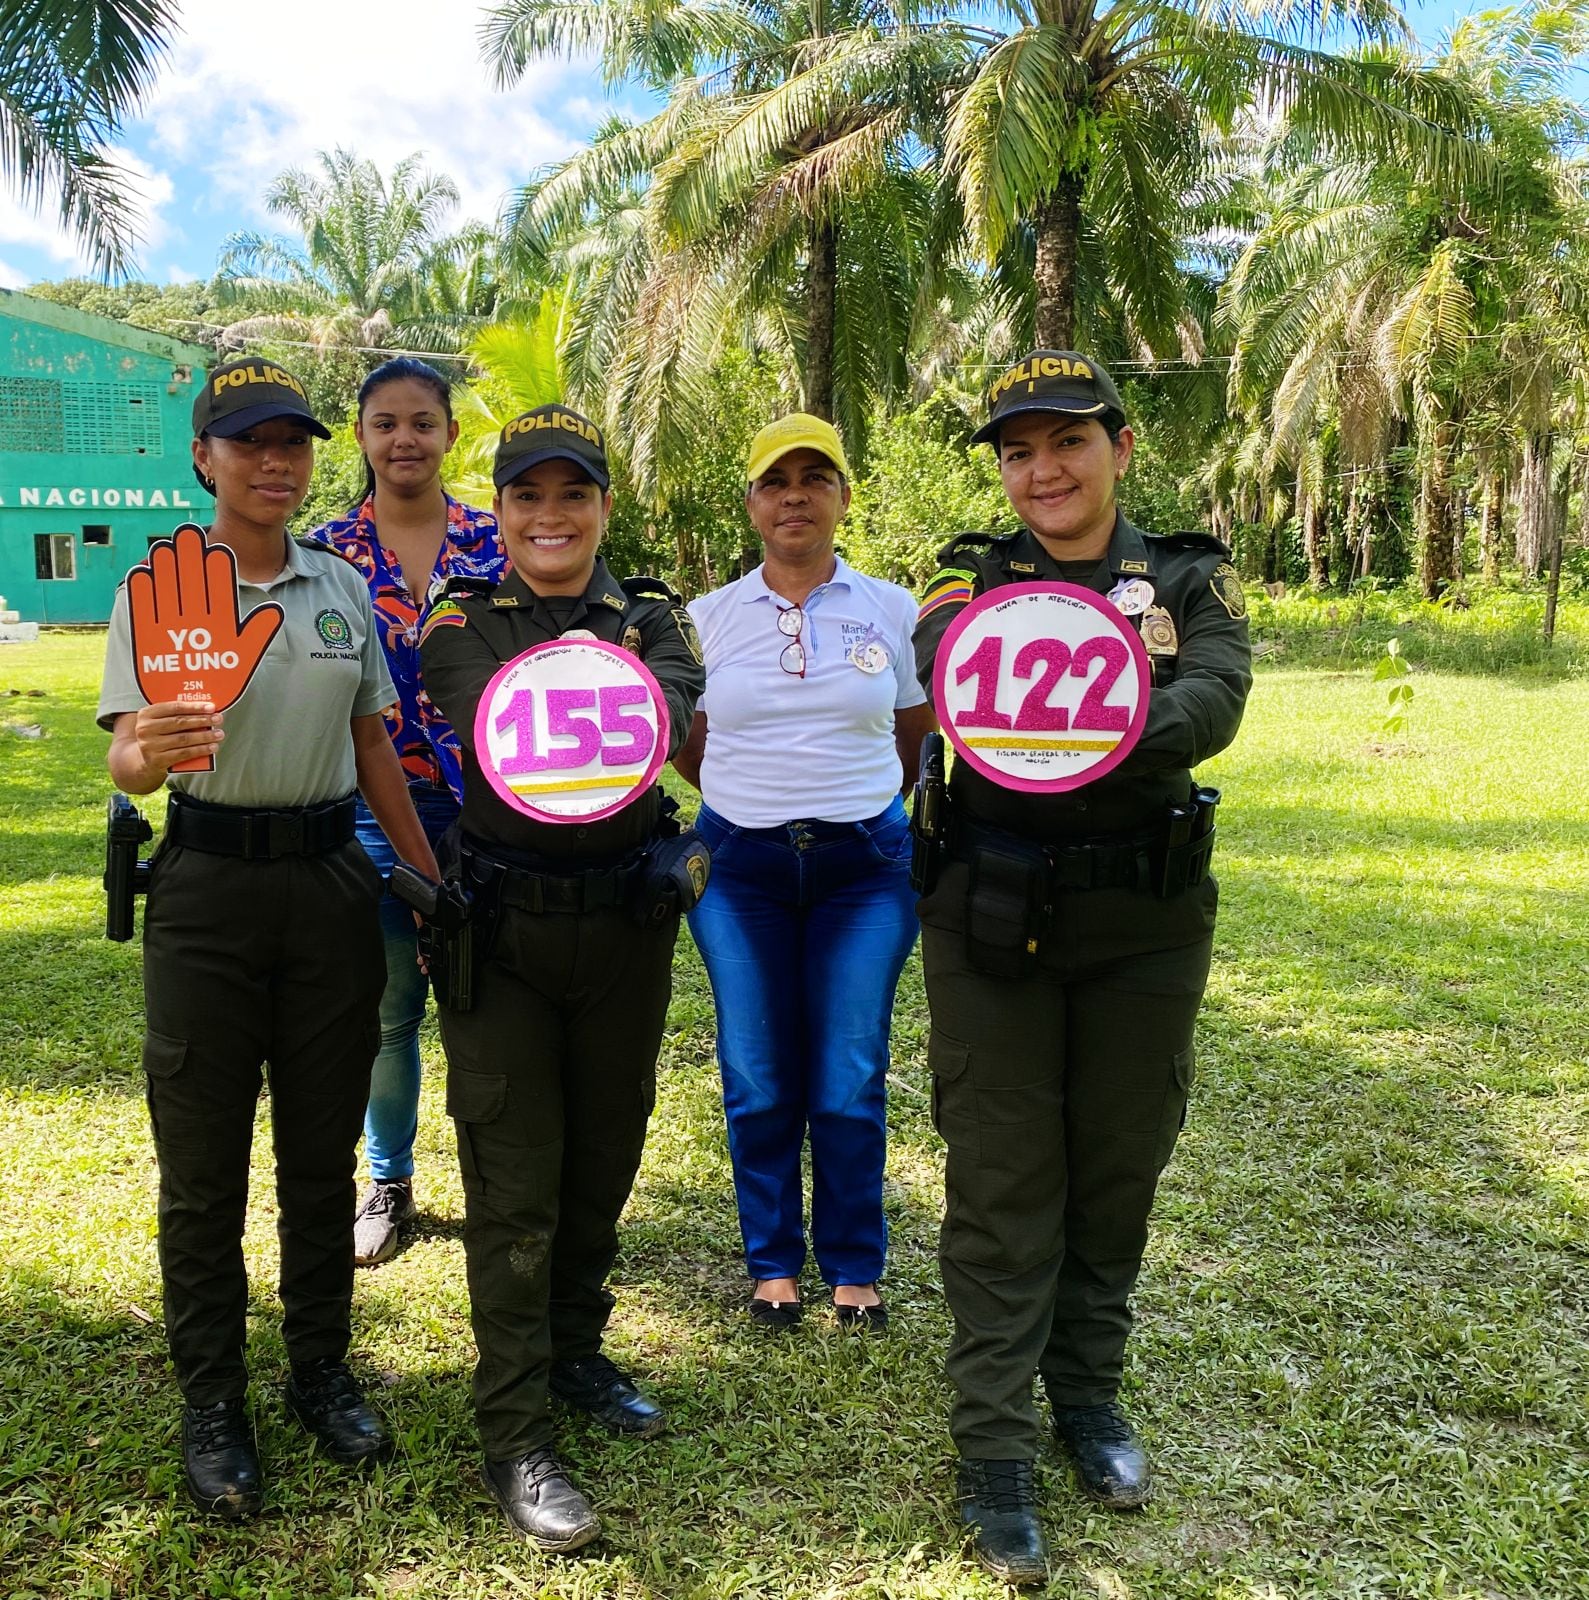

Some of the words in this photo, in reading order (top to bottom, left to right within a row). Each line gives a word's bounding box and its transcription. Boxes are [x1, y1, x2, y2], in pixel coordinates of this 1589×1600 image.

[990, 357, 1093, 402] POLICIA
[505, 411, 600, 447] POLICIA
[20, 487, 191, 507] NACIONAL
[167, 627, 212, 651] YO
[142, 653, 180, 673] ME
[185, 651, 239, 671] UNO
[183, 680, 204, 691] 25N
[955, 636, 1130, 731] 122
[495, 685, 654, 775] 155
